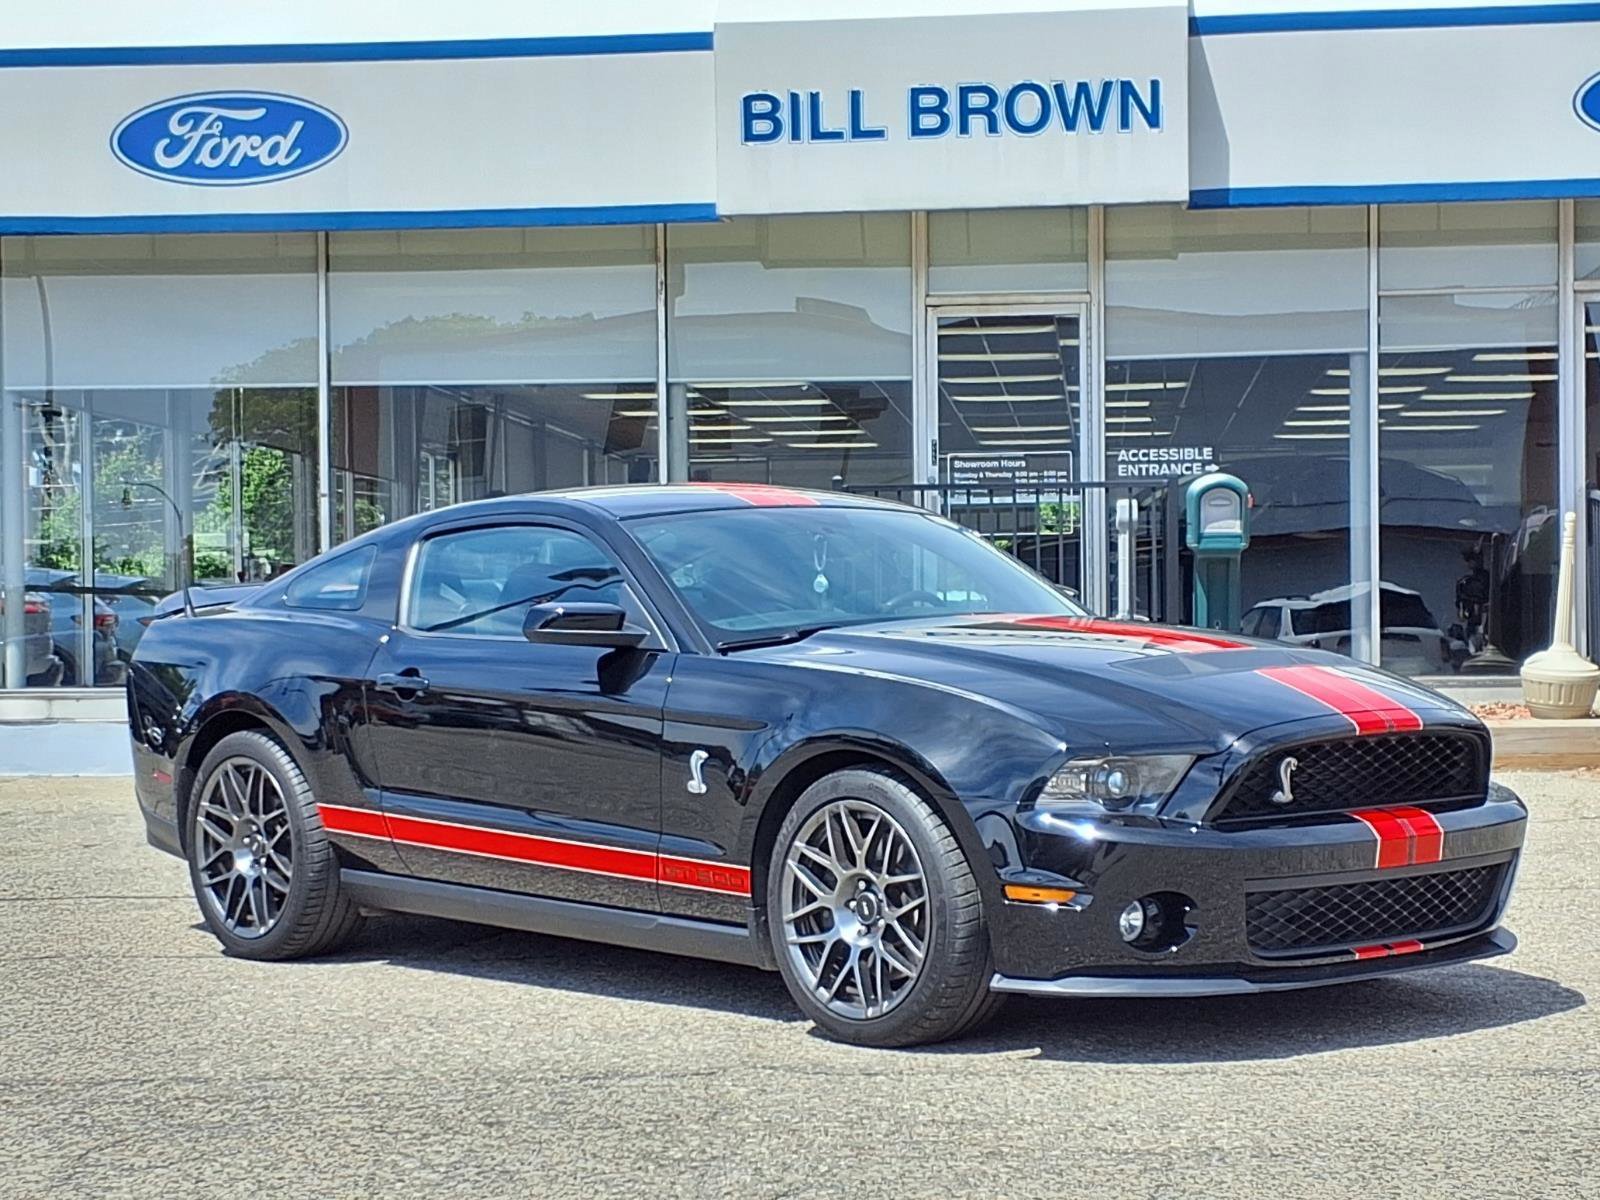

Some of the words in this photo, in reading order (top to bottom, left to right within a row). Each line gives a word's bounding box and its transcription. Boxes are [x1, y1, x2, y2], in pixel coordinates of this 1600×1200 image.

[741, 89, 888, 144] BILL
[907, 78, 1163, 139] BROWN
[154, 106, 304, 169] Ford
[1118, 447, 1213, 461] ACCESSIBLE
[954, 460, 999, 468] Showroom
[1000, 459, 1026, 467] Hours
[1118, 463, 1202, 476] ENTRANCE
